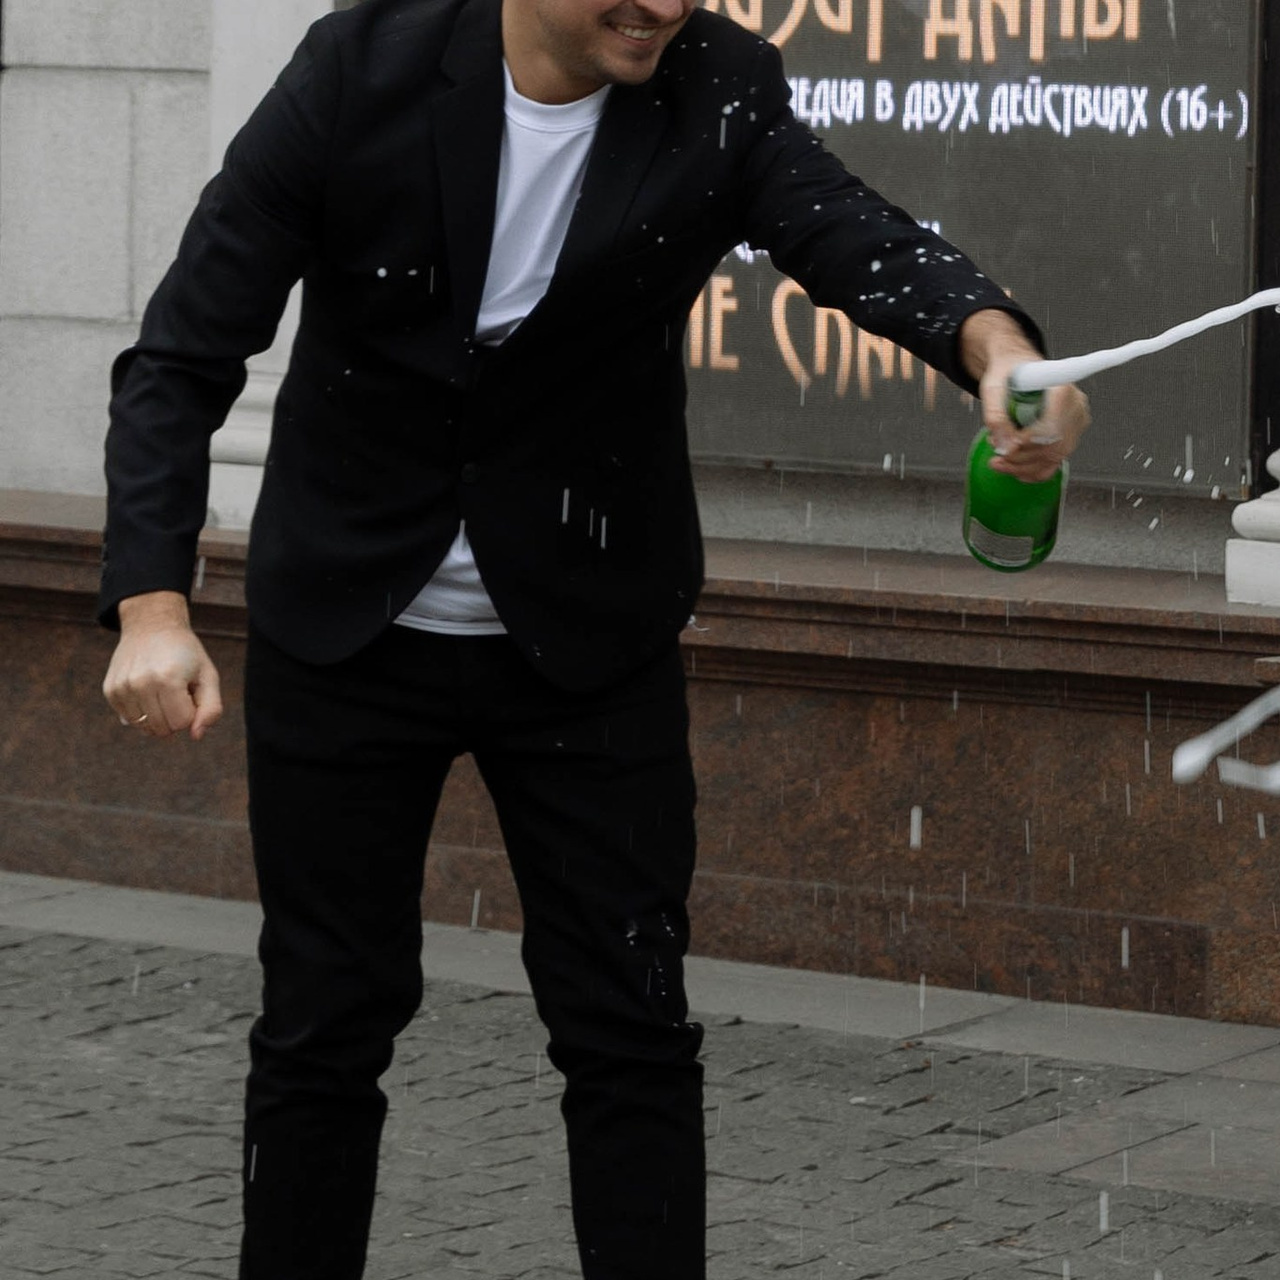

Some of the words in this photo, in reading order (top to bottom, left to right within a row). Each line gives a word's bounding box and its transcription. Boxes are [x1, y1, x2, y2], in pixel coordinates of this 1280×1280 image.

[876, 80, 895, 122] В
[903, 80, 980, 132] ДВУХ
[989, 75, 1149, 137] ДЕЙСТВИЯХ
[1161, 85, 1250, 140] (16+)
